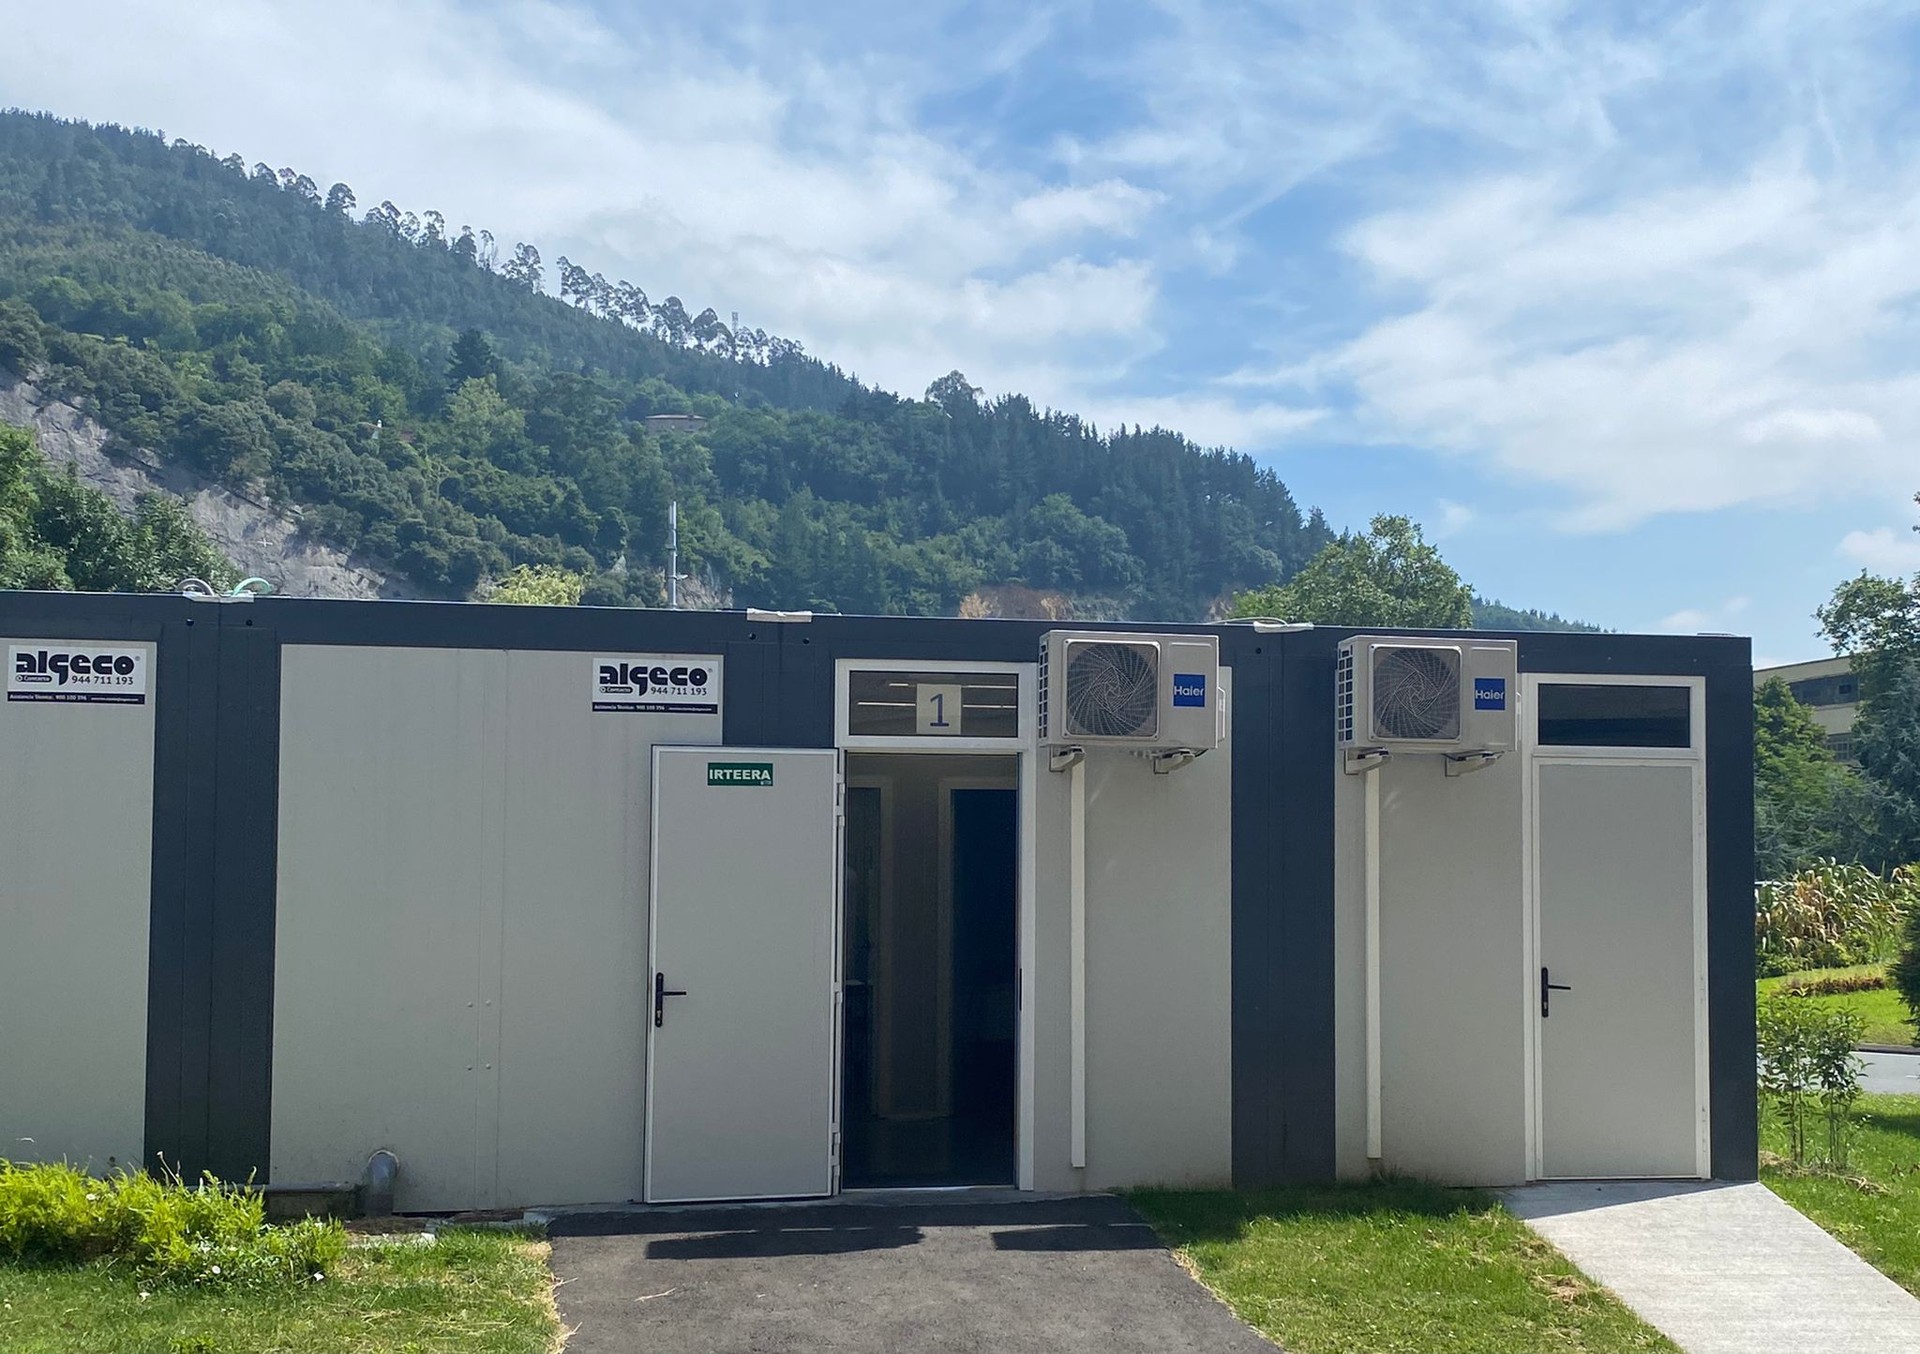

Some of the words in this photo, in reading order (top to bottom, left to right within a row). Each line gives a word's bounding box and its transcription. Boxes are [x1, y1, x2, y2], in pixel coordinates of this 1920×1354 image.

[16, 651, 135, 685] algeco
[71, 675, 91, 684] 944
[93, 676, 112, 685] 711
[115, 677, 134, 685] 193
[599, 663, 708, 696] algeco
[650, 686, 668, 695] 944
[671, 687, 687, 695] 711
[690, 687, 707, 696] 193
[1174, 685, 1204, 697] Haier
[1475, 689, 1504, 700] Haier
[929, 693, 950, 727] 1
[709, 769, 771, 780] IRTEERA
